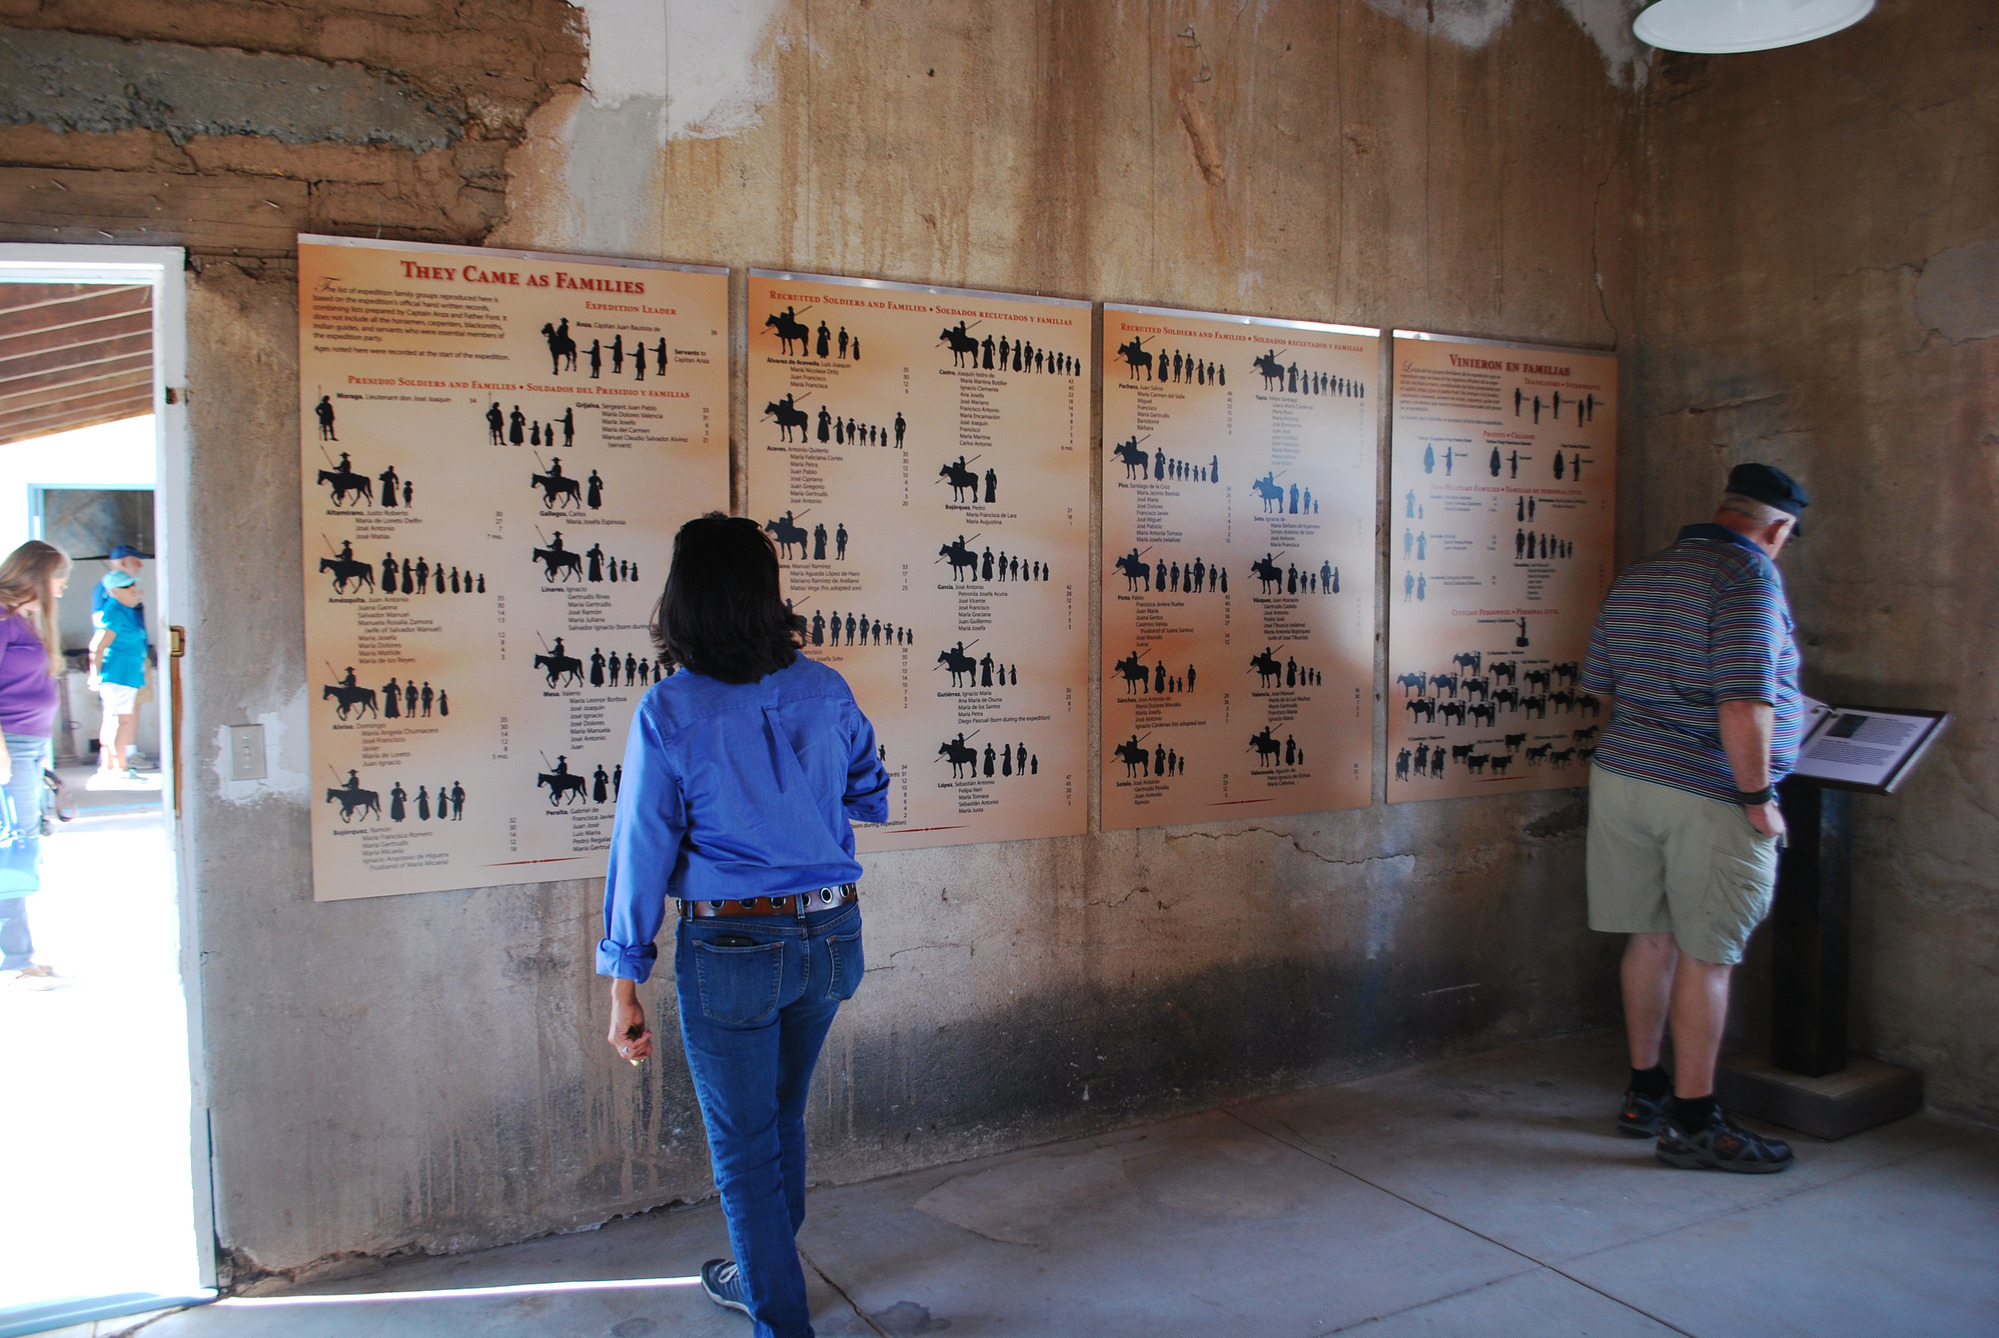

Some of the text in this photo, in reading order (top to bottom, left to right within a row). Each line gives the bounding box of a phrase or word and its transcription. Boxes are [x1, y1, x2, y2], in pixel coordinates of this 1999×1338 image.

[401, 260, 644, 294] THEY CAME AS FAMILIES
[585, 301, 677, 315] EXPEDITION LEADER
[770, 290, 820, 303] RECRUITED
[824, 296, 865, 307] SOLDIERS
[888, 301, 927, 313] FAMILIES
[936, 306, 976, 317] SOLDADOS
[980, 311, 1028, 322] RECLUTADOS
[1037, 317, 1073, 326] FAMILIAS
[1121, 322, 1161, 334] RECRUITED
[1164, 327, 1197, 337] SOLDIERS
[1215, 331, 1246, 342] FAMILIES
[1253, 335, 1286, 345] SOLDADOS
[1288, 340, 1327, 349] RECLUTADOS
[1334, 344, 1363, 352] FAMILIAS
[1449, 353, 1570, 376] VINIERON EN FAMILIAS
[348, 375, 396, 386] PRESIDIO
[398, 378, 445, 388] SOLDIERS
[449, 381, 468, 389] AND
[471, 380, 516, 391] FAMILIES
[526, 383, 574, 393] SOLDADOS
[596, 386, 638, 396] PRESIDIO
[649, 390, 690, 398] FAMILIAS
